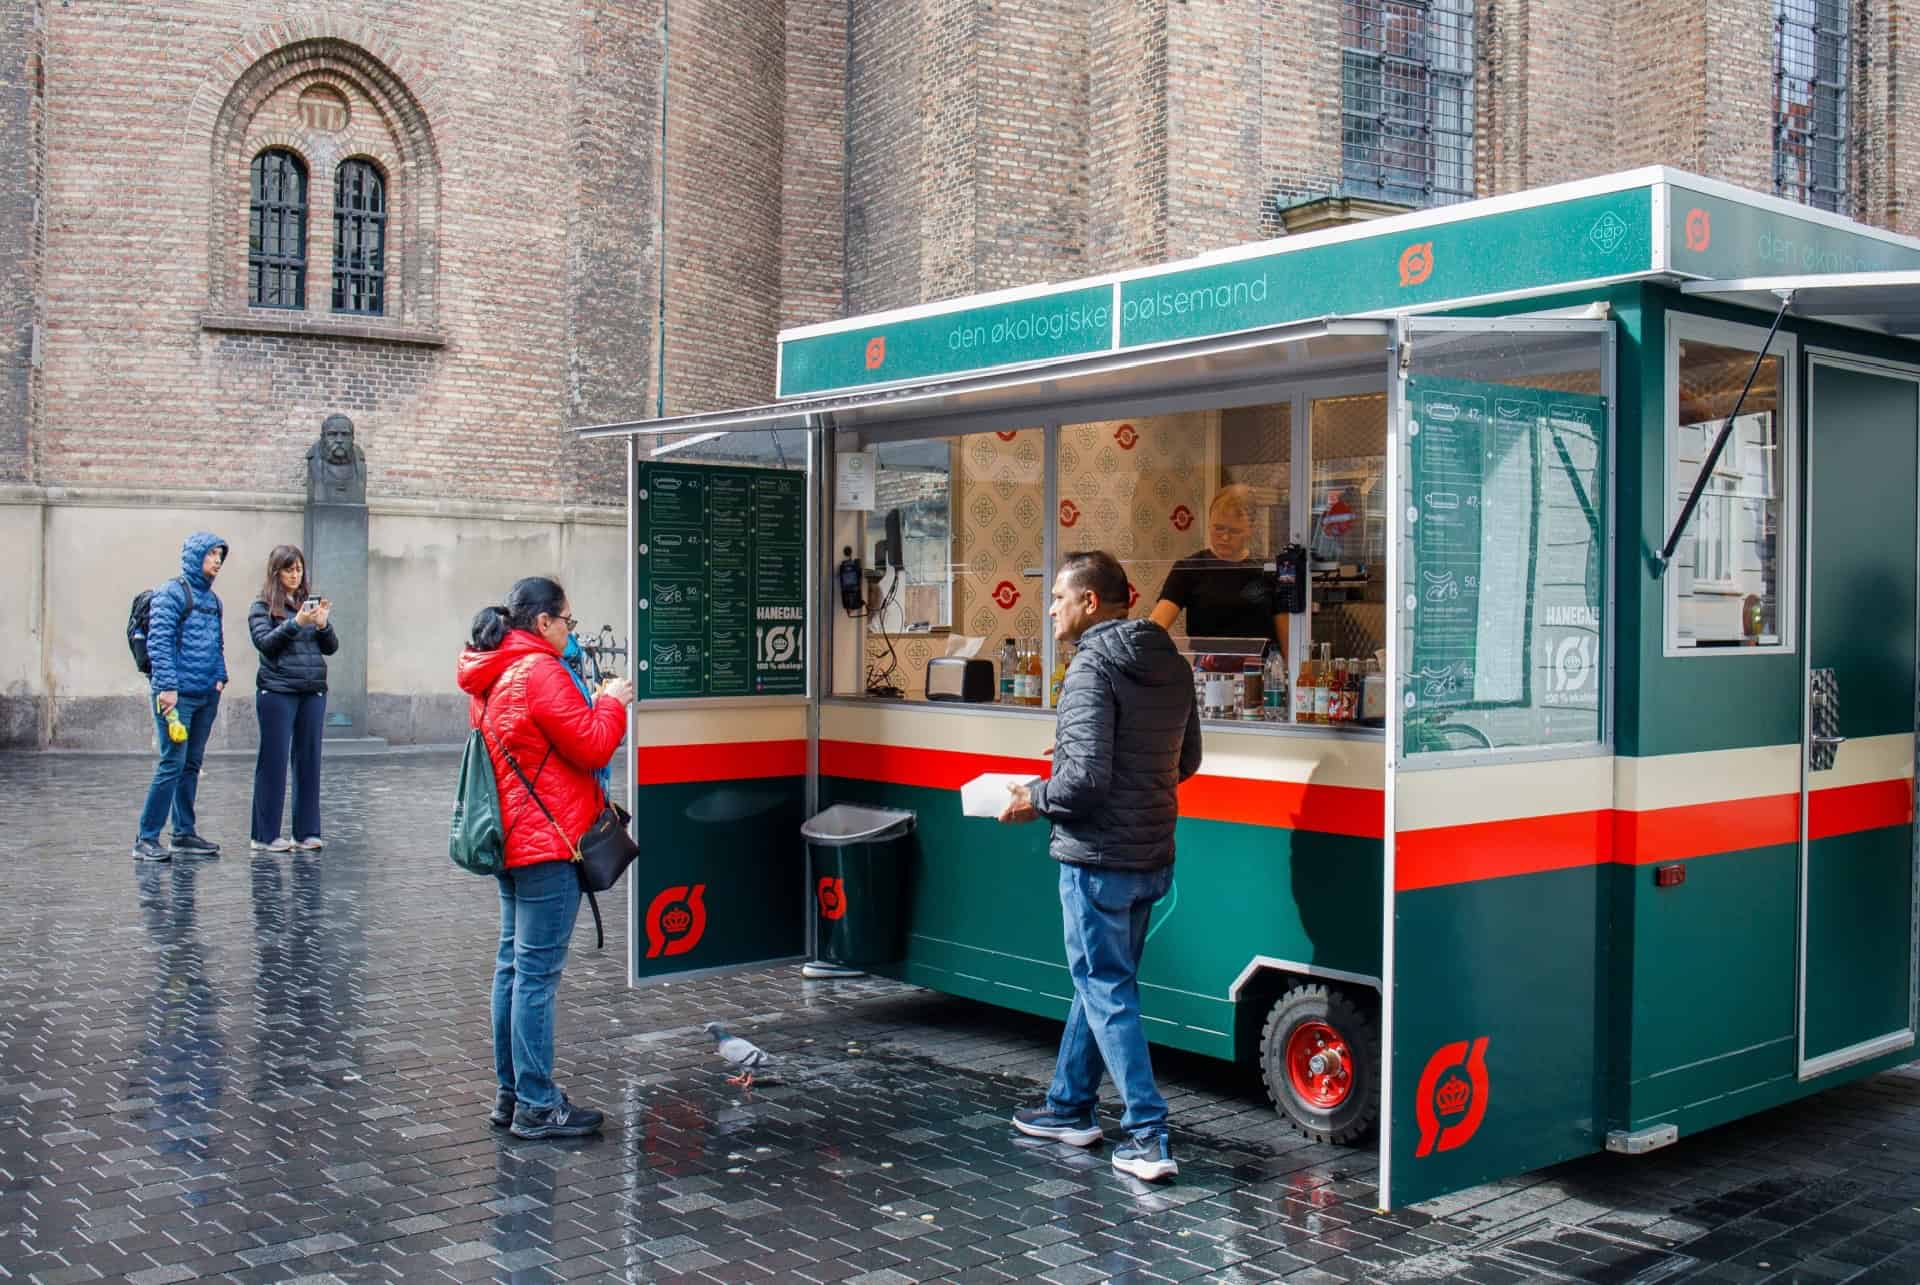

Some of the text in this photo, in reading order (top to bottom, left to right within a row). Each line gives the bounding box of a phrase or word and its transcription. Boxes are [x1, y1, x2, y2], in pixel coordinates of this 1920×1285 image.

[949, 272, 1268, 350] den økologiske pølsemand
